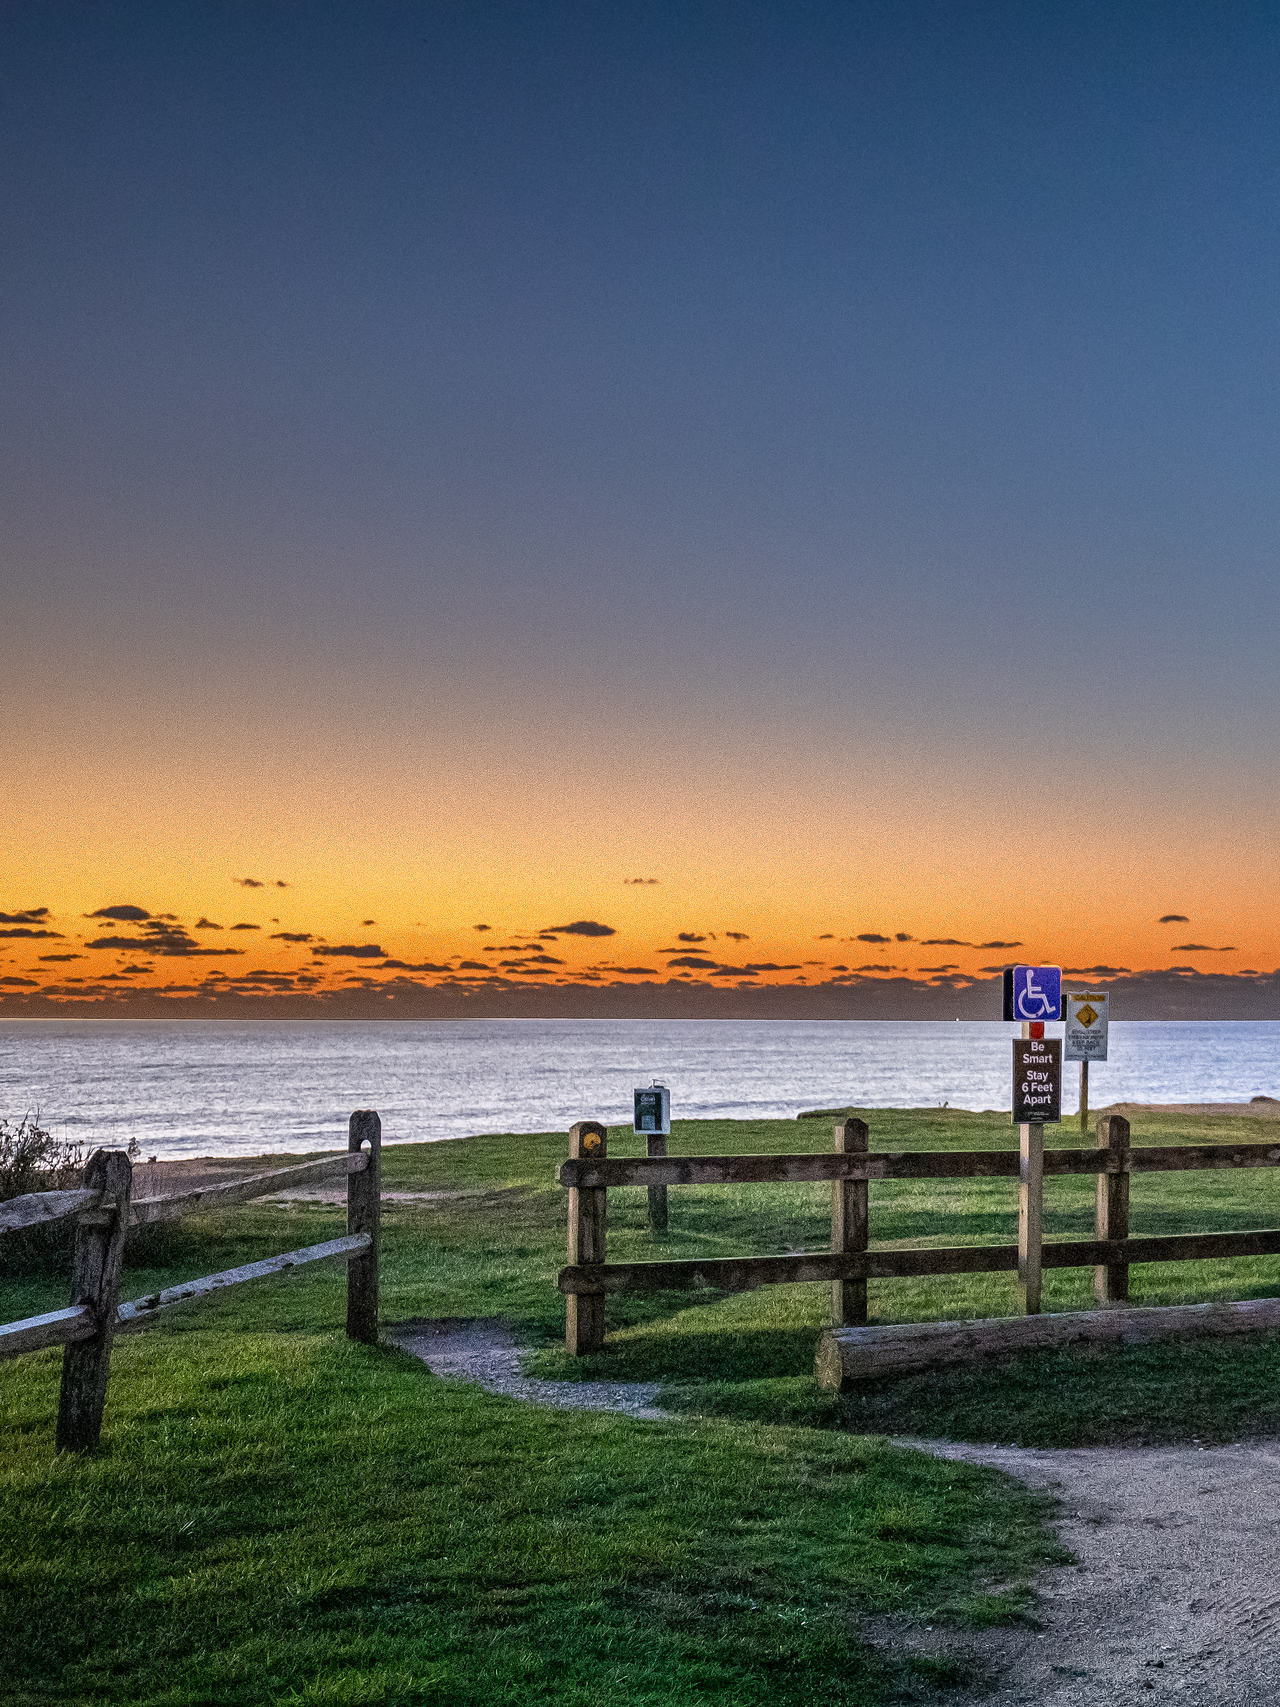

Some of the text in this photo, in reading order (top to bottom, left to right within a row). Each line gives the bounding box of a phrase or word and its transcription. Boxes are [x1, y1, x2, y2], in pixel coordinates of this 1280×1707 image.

[1031, 1041, 1045, 1051] Be
[1022, 1053, 1053, 1064] Smart
[1026, 1070, 1049, 1082] Stay
[1021, 1082, 1053, 1093] 6 Feet
[1023, 1094, 1052, 1107] Apart
